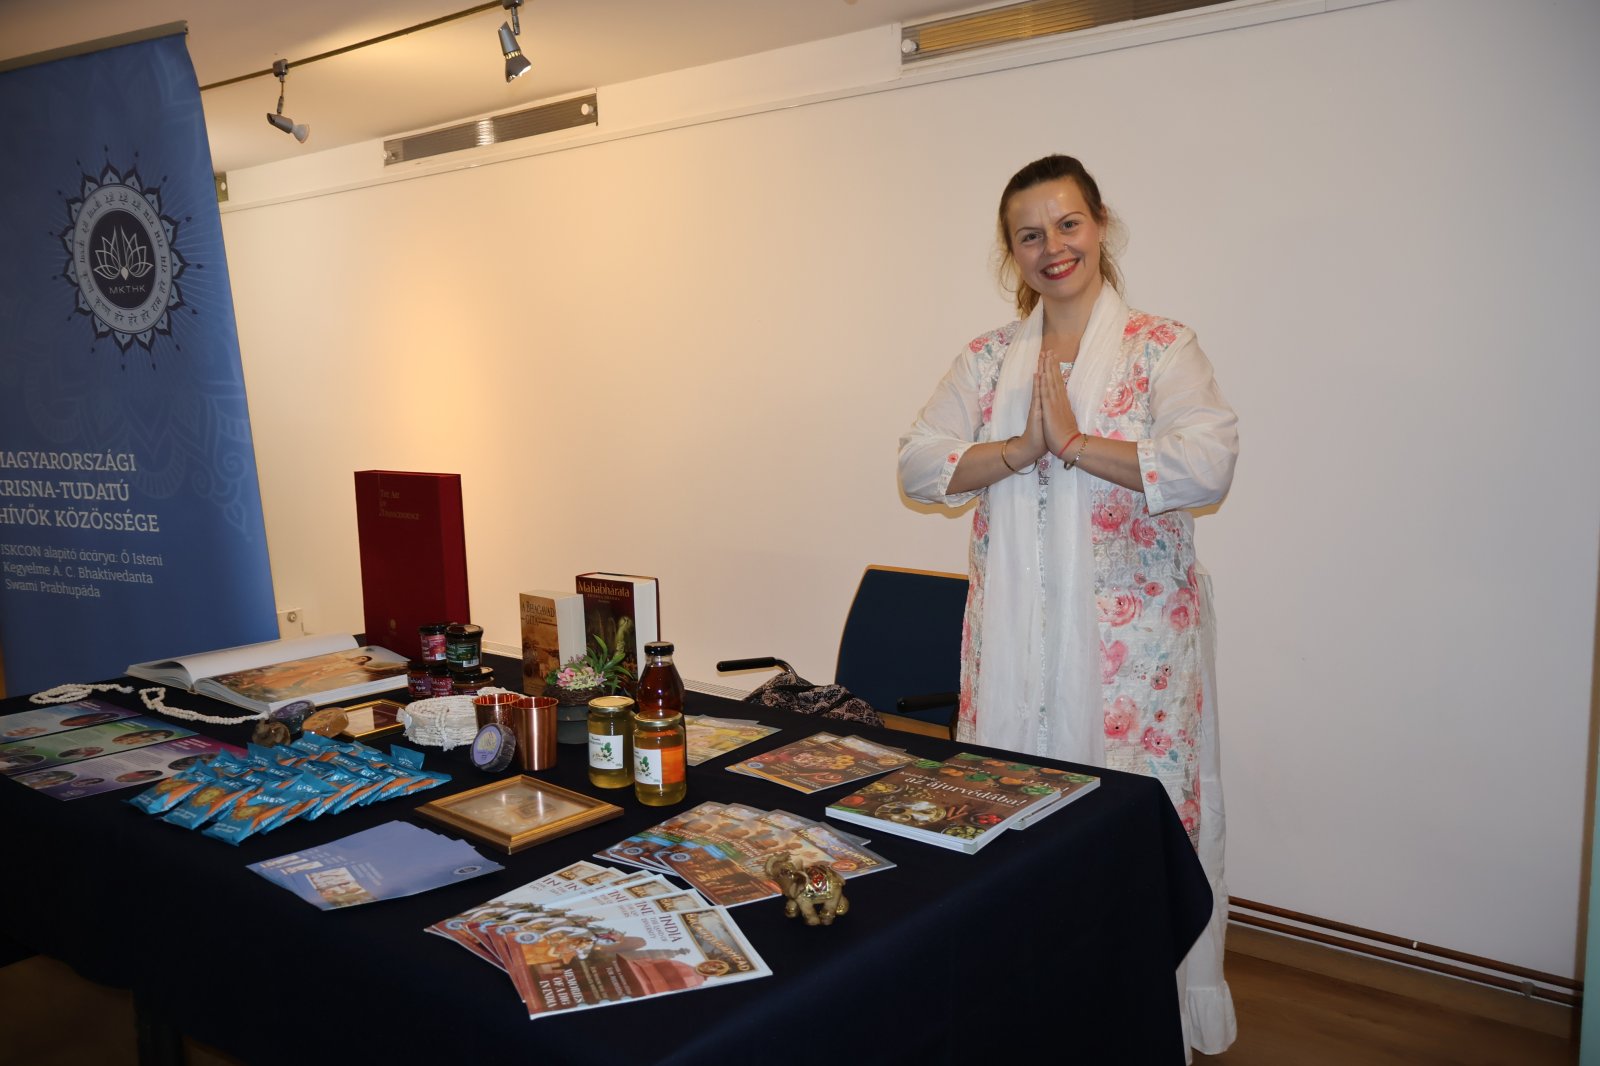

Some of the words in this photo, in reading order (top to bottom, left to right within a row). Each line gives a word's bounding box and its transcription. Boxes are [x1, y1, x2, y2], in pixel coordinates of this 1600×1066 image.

[109, 284, 146, 295] MKTHK
[54, 507, 160, 532] KÖZÖSSÉGE
[133, 553, 163, 566] Isteni
[3, 562, 50, 577] Kegyelme
[78, 567, 153, 584] Bhaktivedanta
[5, 579, 38, 591] Swami
[659, 914, 683, 943] INDIA
[539, 980, 551, 989] IN
[553, 977, 564, 987] OF
[563, 968, 585, 1004] MEMORIES
[542, 988, 557, 1008] INDIA
